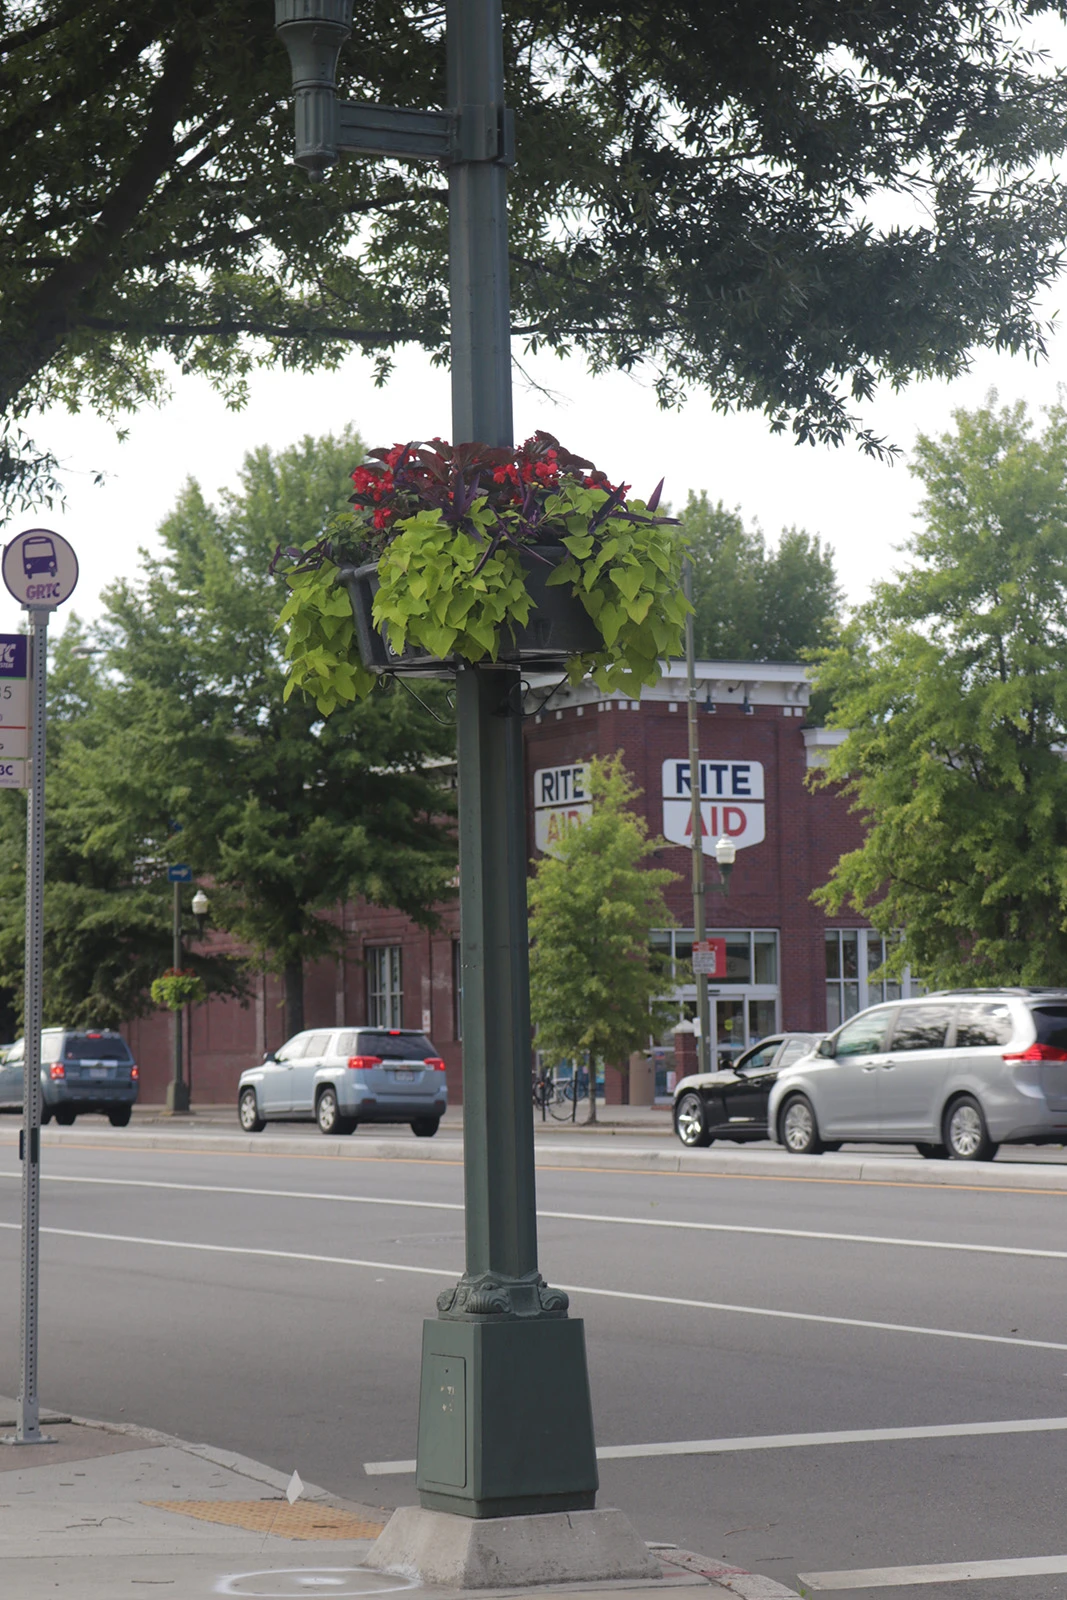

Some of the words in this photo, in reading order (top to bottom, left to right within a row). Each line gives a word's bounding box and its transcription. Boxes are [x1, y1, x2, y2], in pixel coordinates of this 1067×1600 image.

[26, 582, 60, 600] GRTC
[542, 767, 584, 802] RITE
[676, 763, 752, 795] RITE
[684, 806, 747, 837] AID
